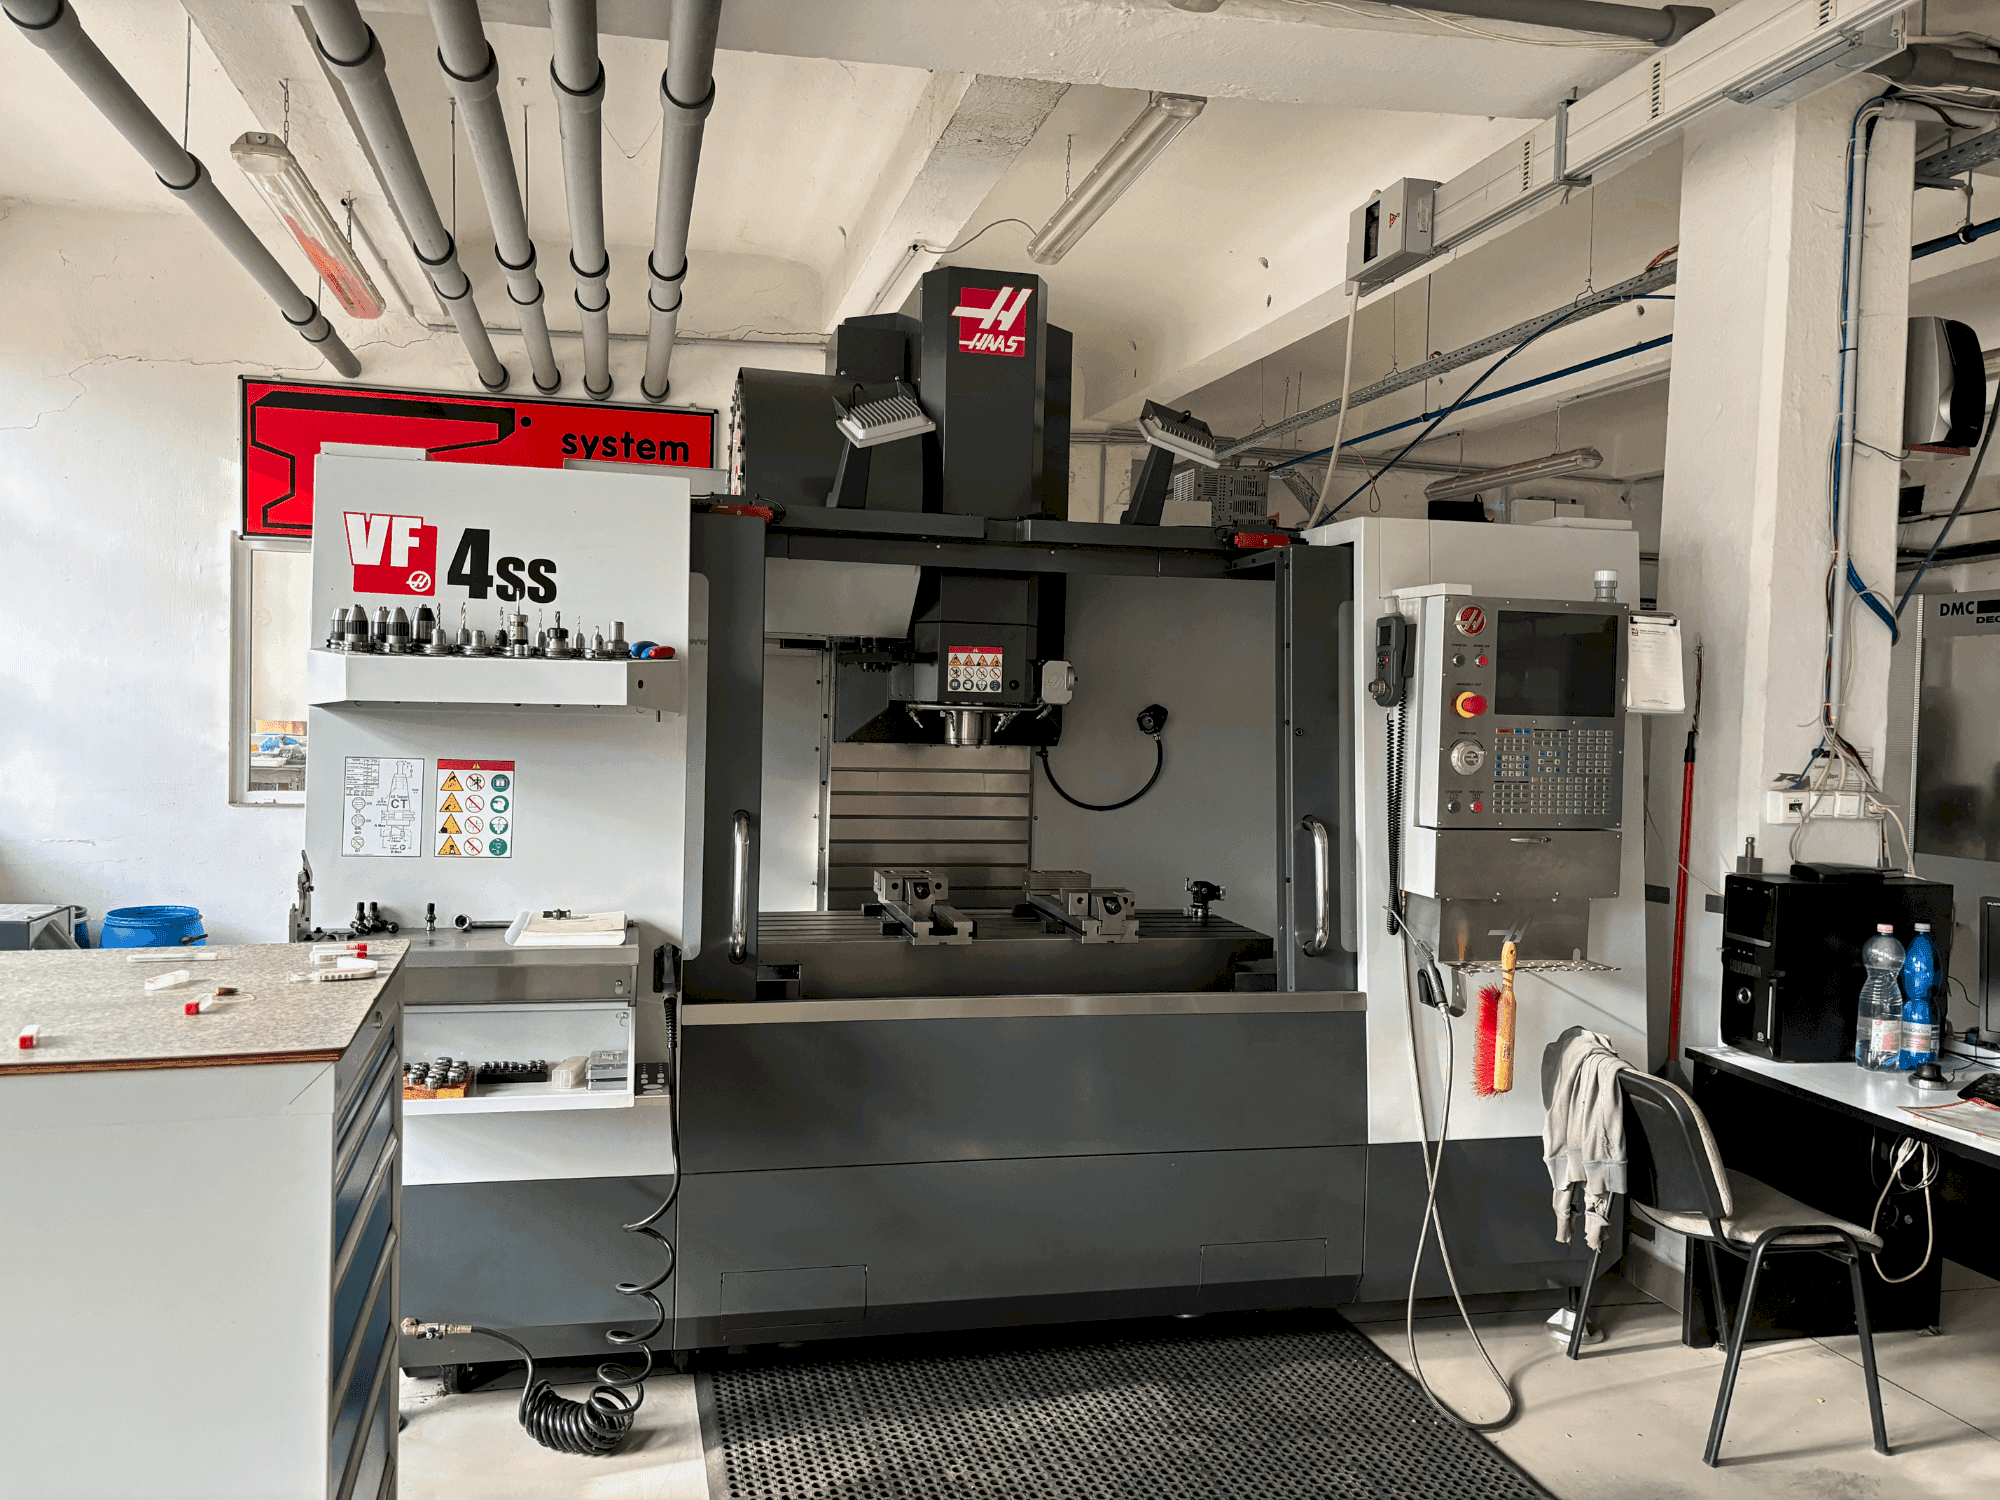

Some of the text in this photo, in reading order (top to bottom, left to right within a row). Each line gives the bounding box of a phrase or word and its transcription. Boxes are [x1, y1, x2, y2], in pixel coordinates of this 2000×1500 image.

[959, 333, 1025, 353] HAAS
[561, 431, 690, 463] system
[343, 511, 424, 567] VF
[1940, 601, 1975, 617] DMC
[391, 799, 408, 809] CT
